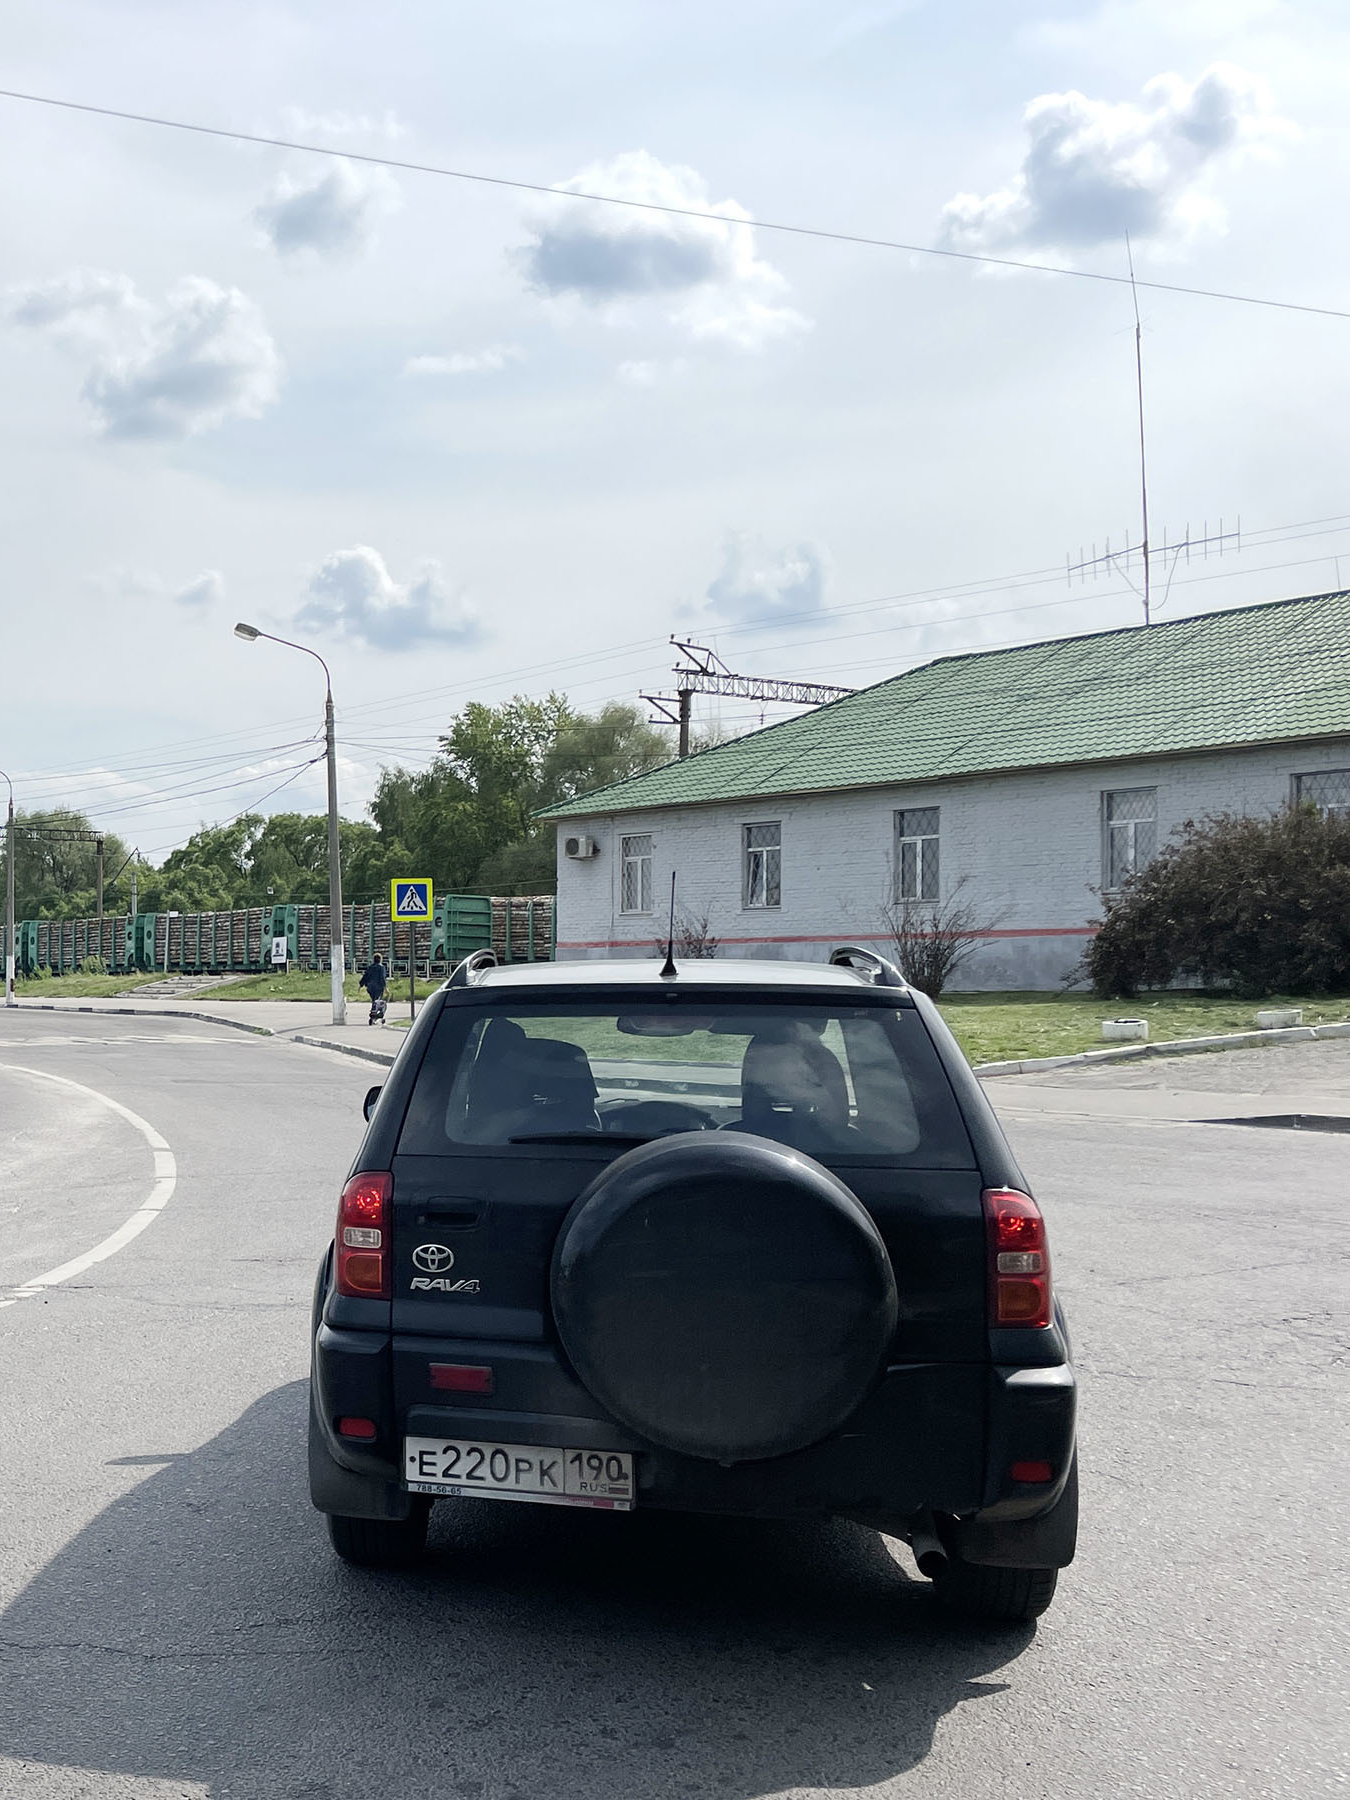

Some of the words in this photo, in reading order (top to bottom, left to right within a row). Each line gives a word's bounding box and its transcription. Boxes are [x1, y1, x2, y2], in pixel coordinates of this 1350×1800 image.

[410, 1277, 481, 1294] RAV4
[570, 1453, 623, 1482] 190
[580, 1481, 608, 1493] RUS
